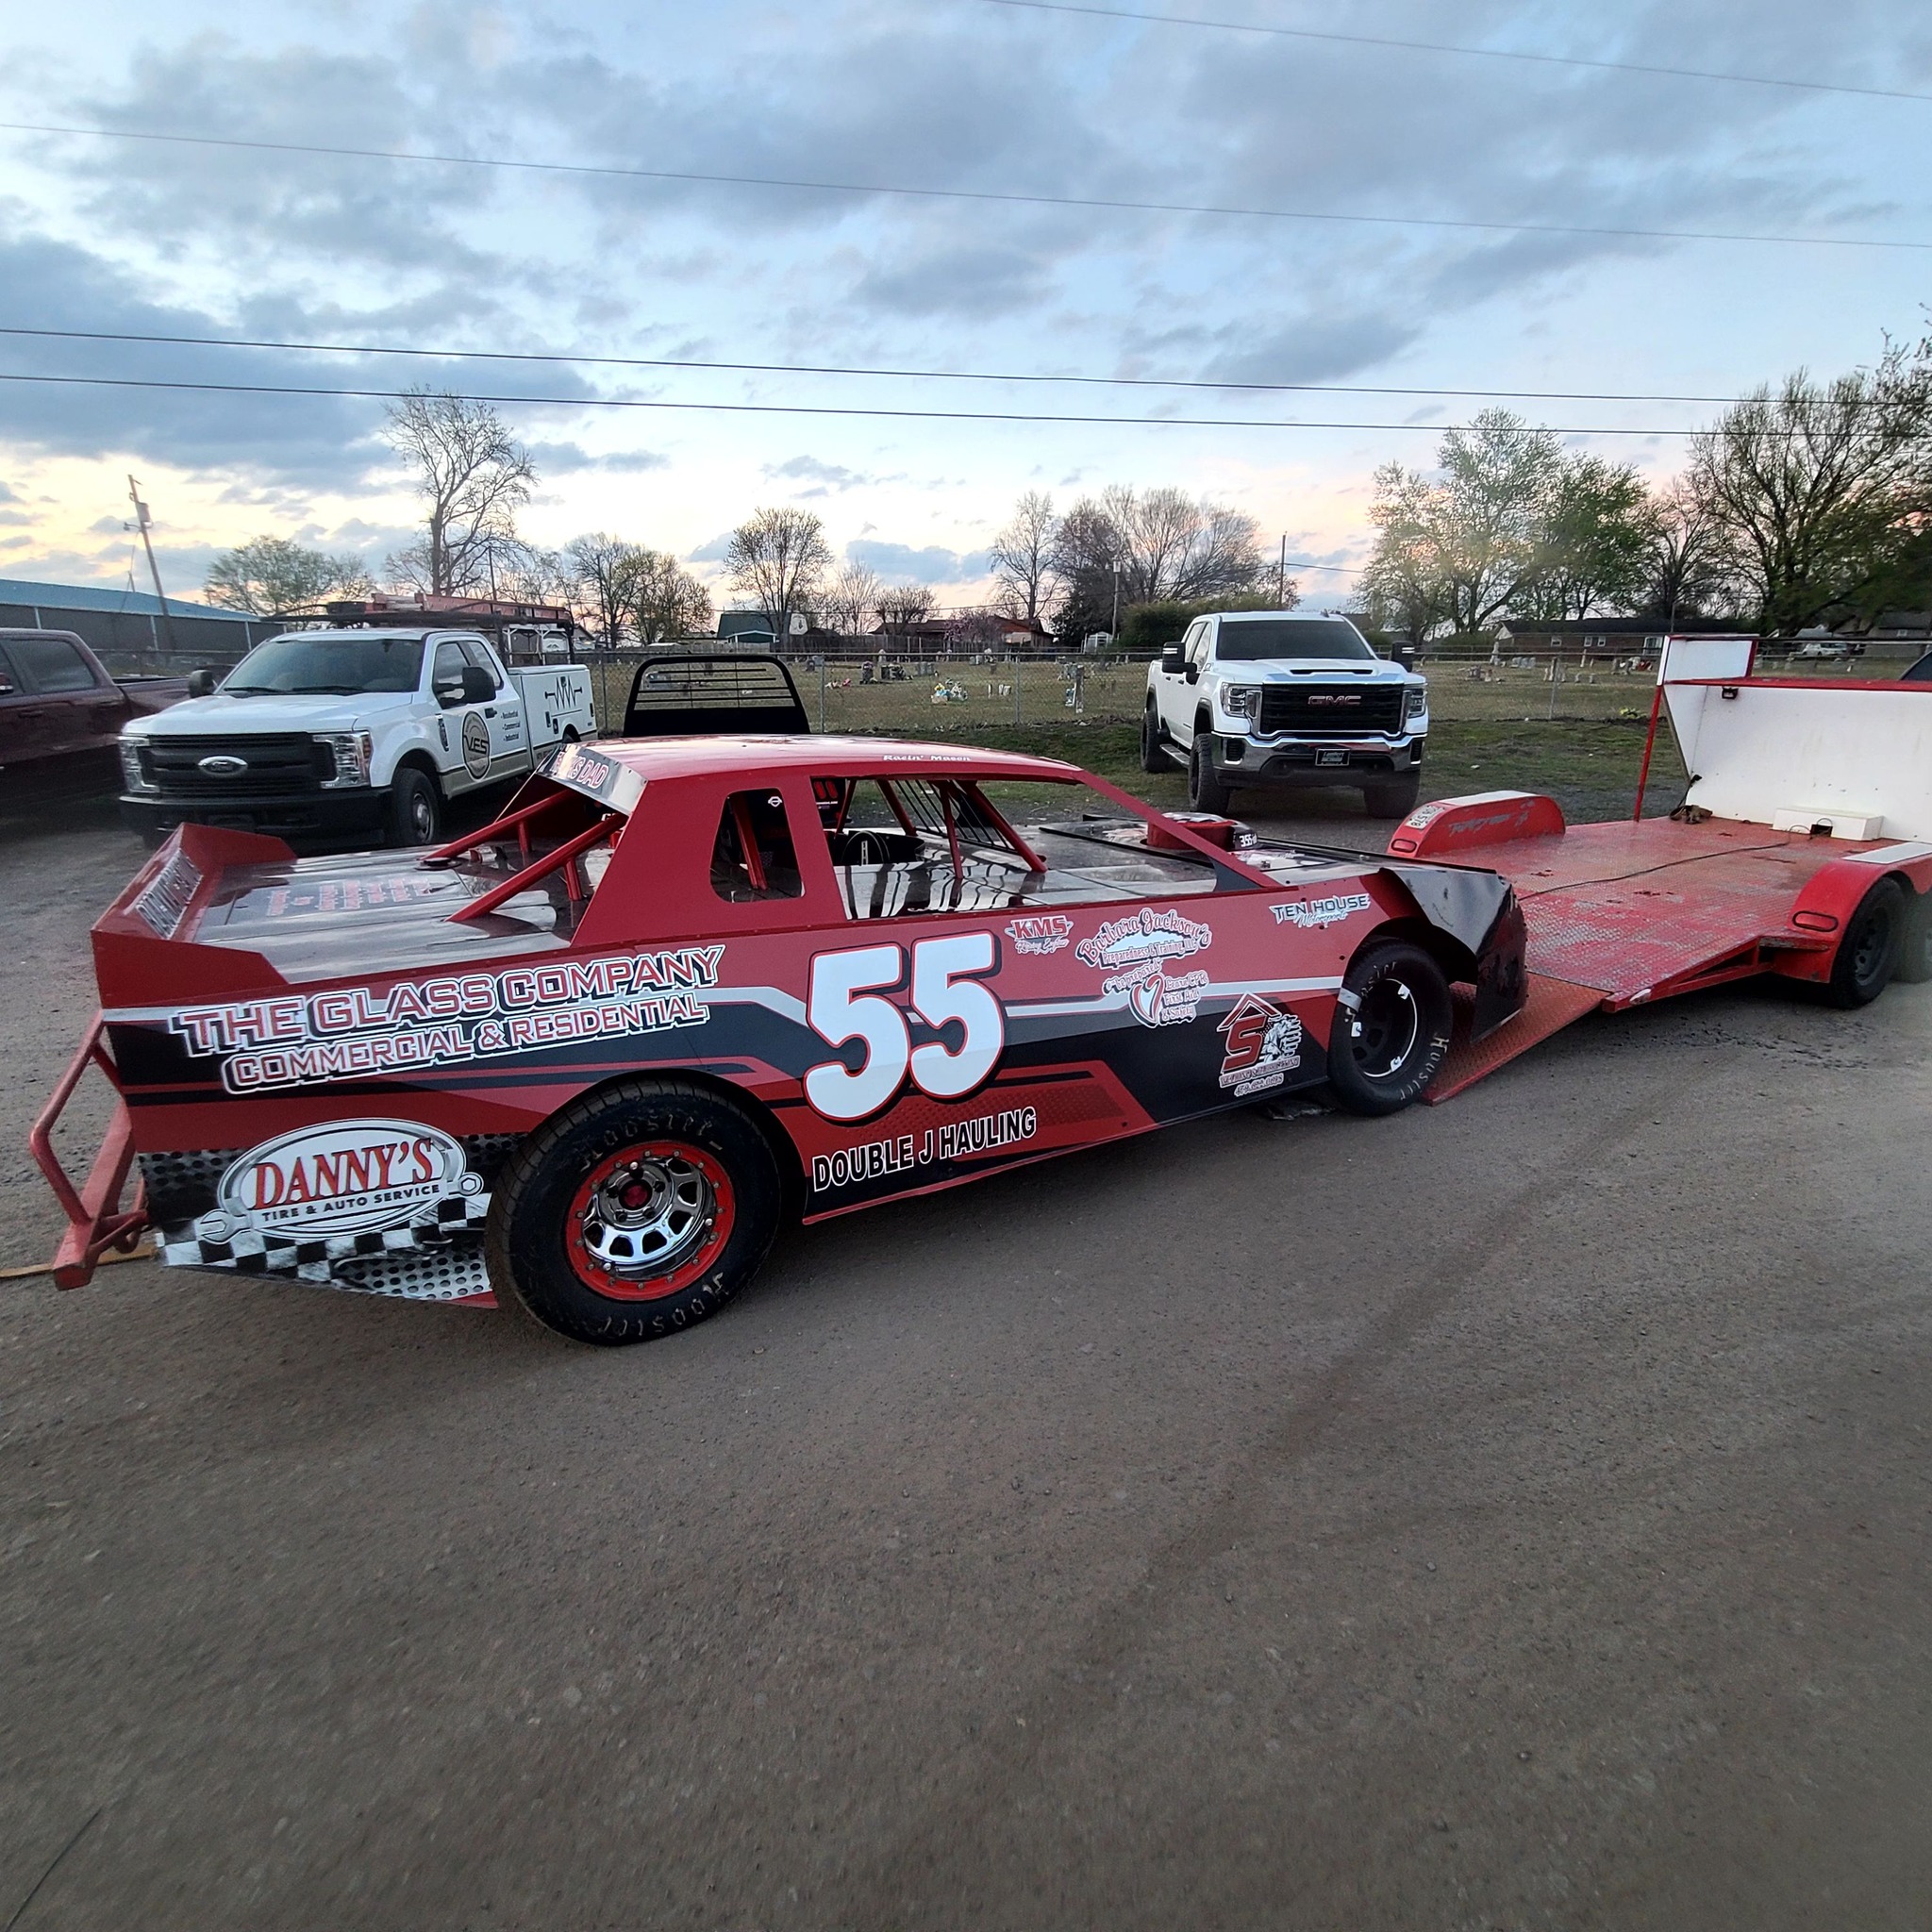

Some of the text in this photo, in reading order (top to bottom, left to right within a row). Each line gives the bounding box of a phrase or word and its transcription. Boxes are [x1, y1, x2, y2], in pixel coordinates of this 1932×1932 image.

[1307, 695, 1361, 706] GMC
[576, 759, 608, 789] DAD
[1271, 894, 1371, 922] TEN HOUSE
[1295, 910, 1348, 927] Motorsports
[1013, 918, 1067, 939] KMS
[1078, 916, 1141, 963] Barbara
[1189, 971, 1208, 985] CPR
[174, 946, 724, 1054] THE GLASS COMPANY
[227, 993, 708, 1090] COMMERCIAL & RESIDENTIAL
[803, 929, 1005, 1123] 55
[812, 1106, 1037, 1191] DOUBLE J HAULING
[254, 1137, 434, 1210] DANNY'S
[261, 1183, 441, 1223] TIRE & AUTO SERVICE
